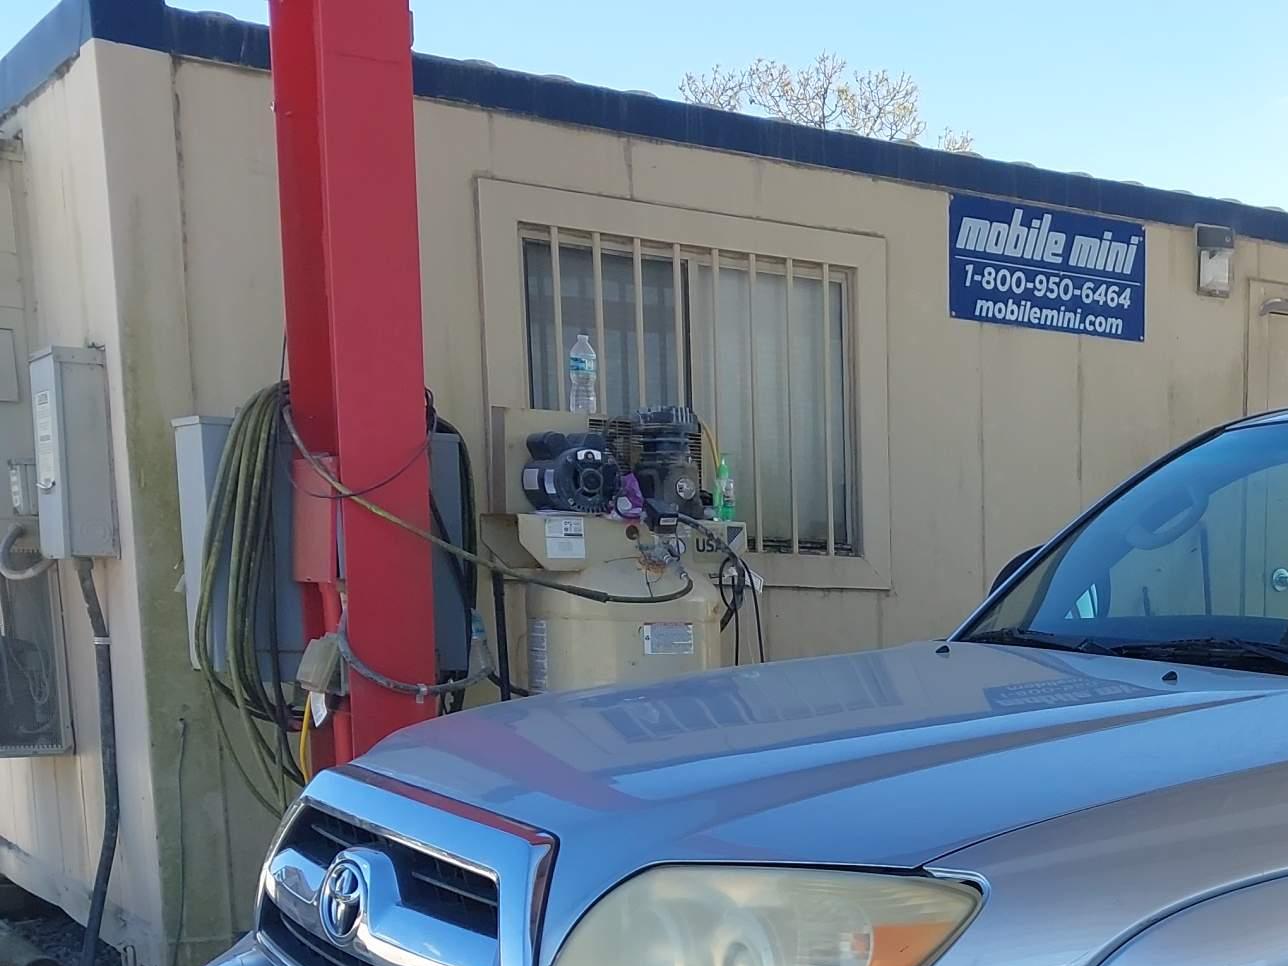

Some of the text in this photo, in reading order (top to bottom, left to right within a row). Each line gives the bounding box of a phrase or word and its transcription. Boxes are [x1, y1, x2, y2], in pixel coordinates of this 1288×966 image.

[956, 208, 1139, 274] mobile mini
[964, 264, 1131, 309] 1-800-950-6464
[975, 299, 1123, 335] mobilemini.com
